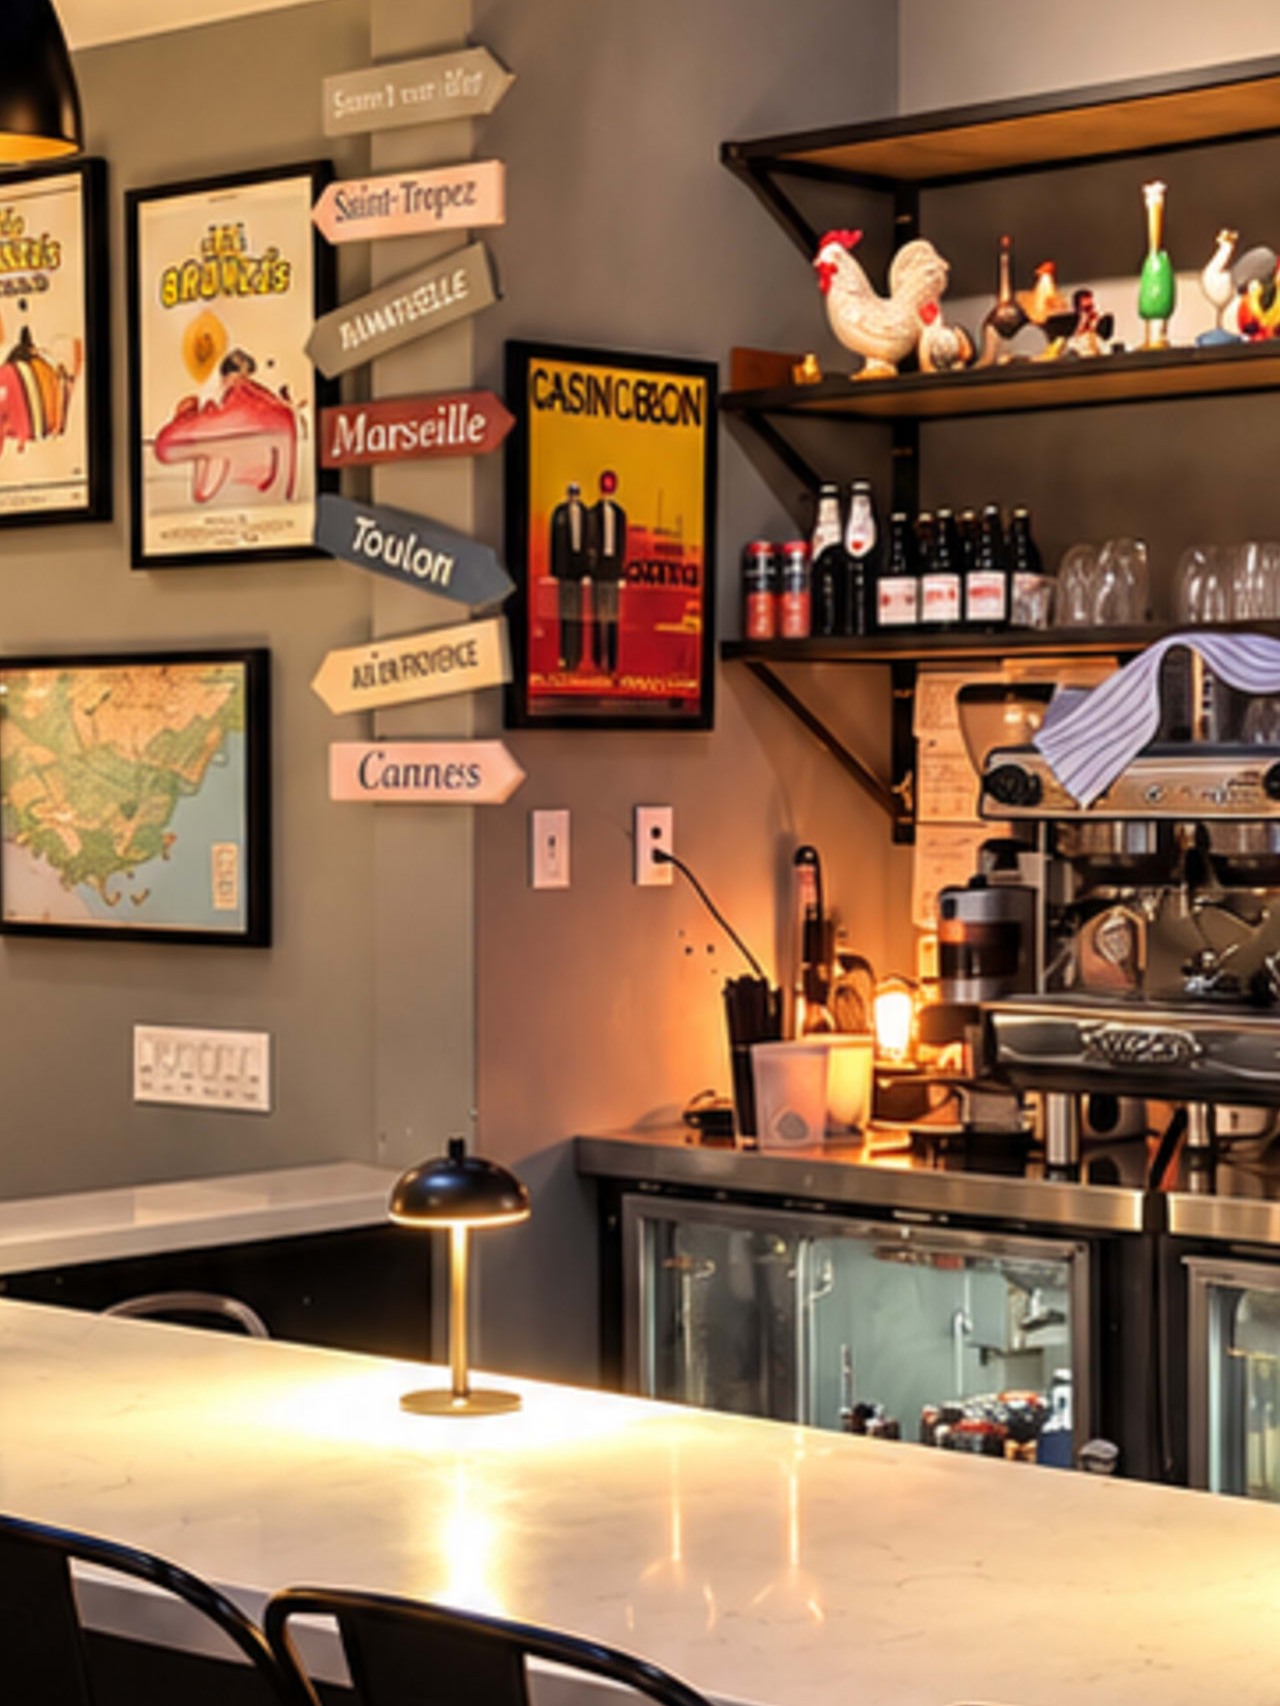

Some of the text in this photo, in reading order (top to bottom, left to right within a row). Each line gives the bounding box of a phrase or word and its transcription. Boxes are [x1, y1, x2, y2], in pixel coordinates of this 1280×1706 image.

[334, 180, 477, 224] Saint-Tropez
[330, 403, 487, 458] Marseille
[351, 516, 456, 587] Toulon
[357, 749, 483, 791] Cannes
